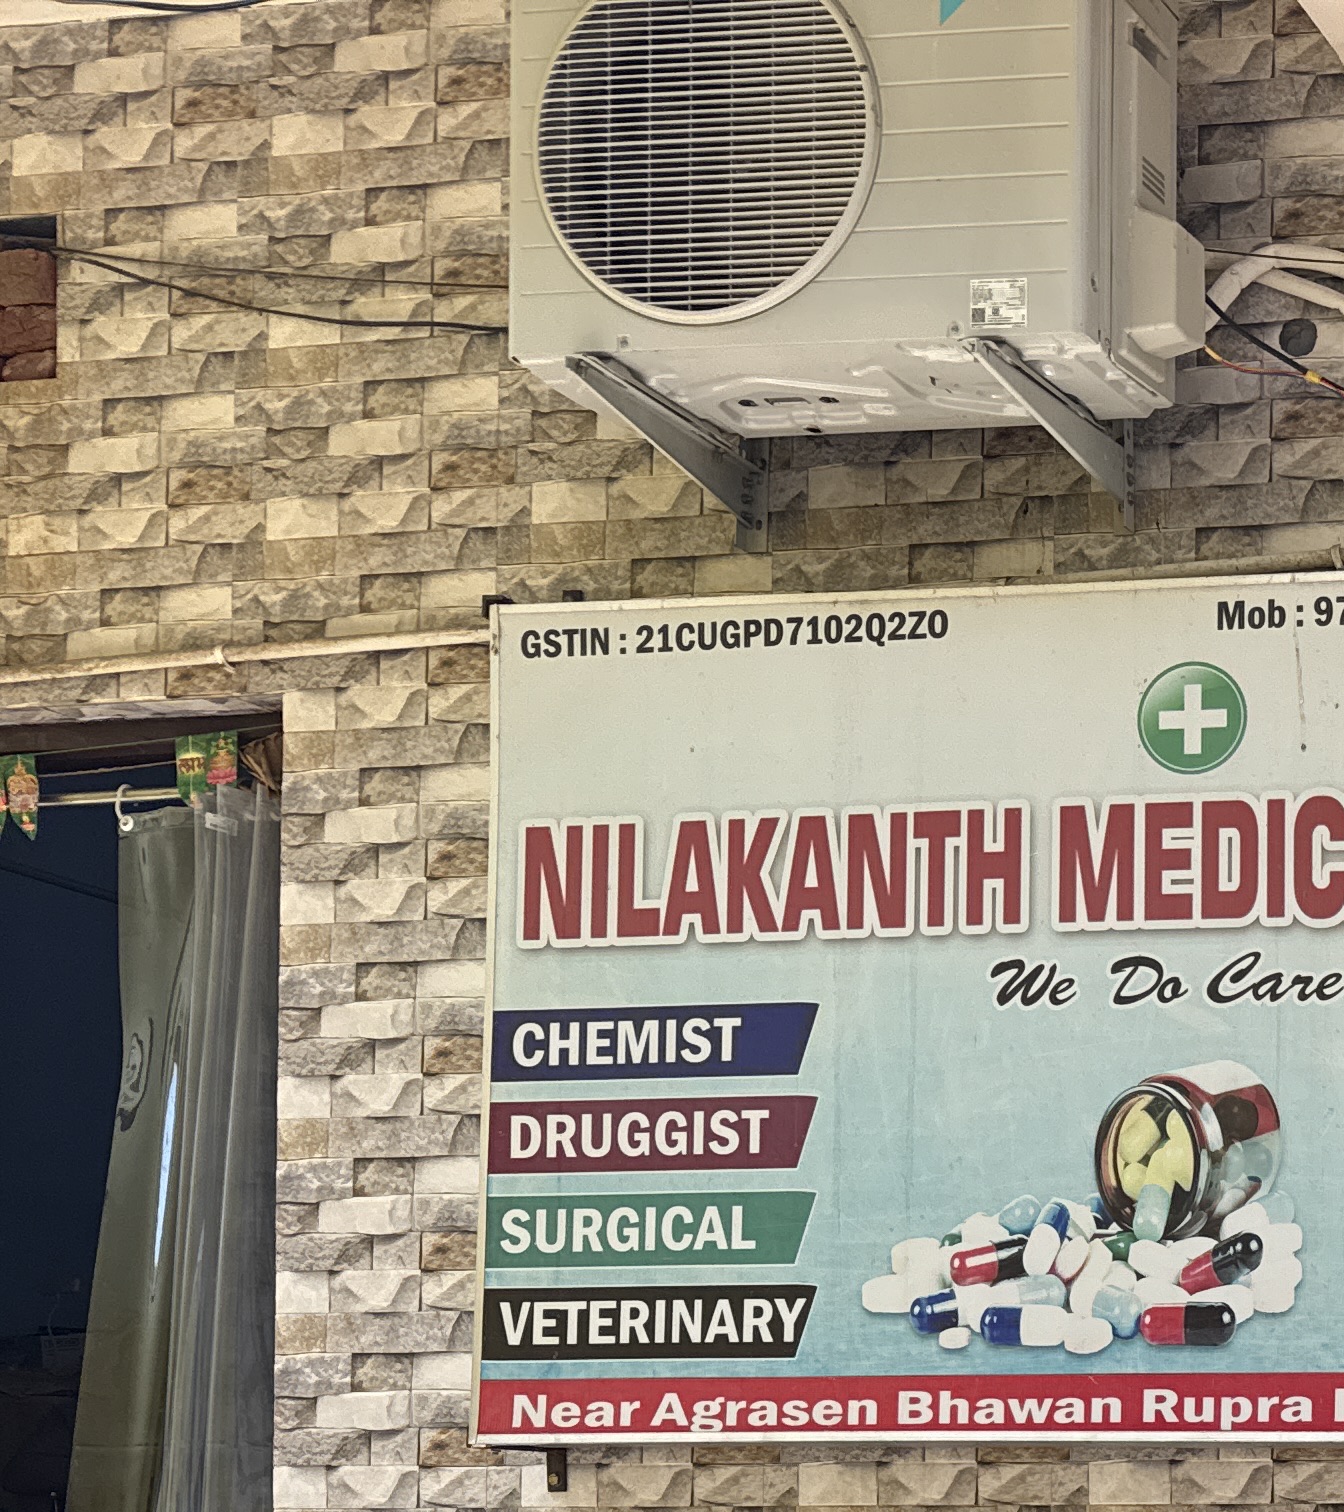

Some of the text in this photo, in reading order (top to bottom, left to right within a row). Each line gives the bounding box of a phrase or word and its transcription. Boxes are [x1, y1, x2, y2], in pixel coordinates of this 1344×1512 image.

[1217, 599, 1286, 630] Mob
[521, 627, 609, 658] GSTIN
[519, 800, 1030, 949] NILAKANTH
[990, 951, 1344, 1007] We Do Care
[512, 1017, 743, 1067] CHEMIST
[509, 1109, 771, 1160] DRUGGIST
[500, 1204, 757, 1254] SURGICAL
[500, 1296, 808, 1347] VETERINARY
[511, 1394, 640, 1428] Near
[650, 1393, 878, 1432] Agrasen
[898, 1391, 1123, 1425] Bhawan
[1142, 1390, 1322, 1431] Rupra
